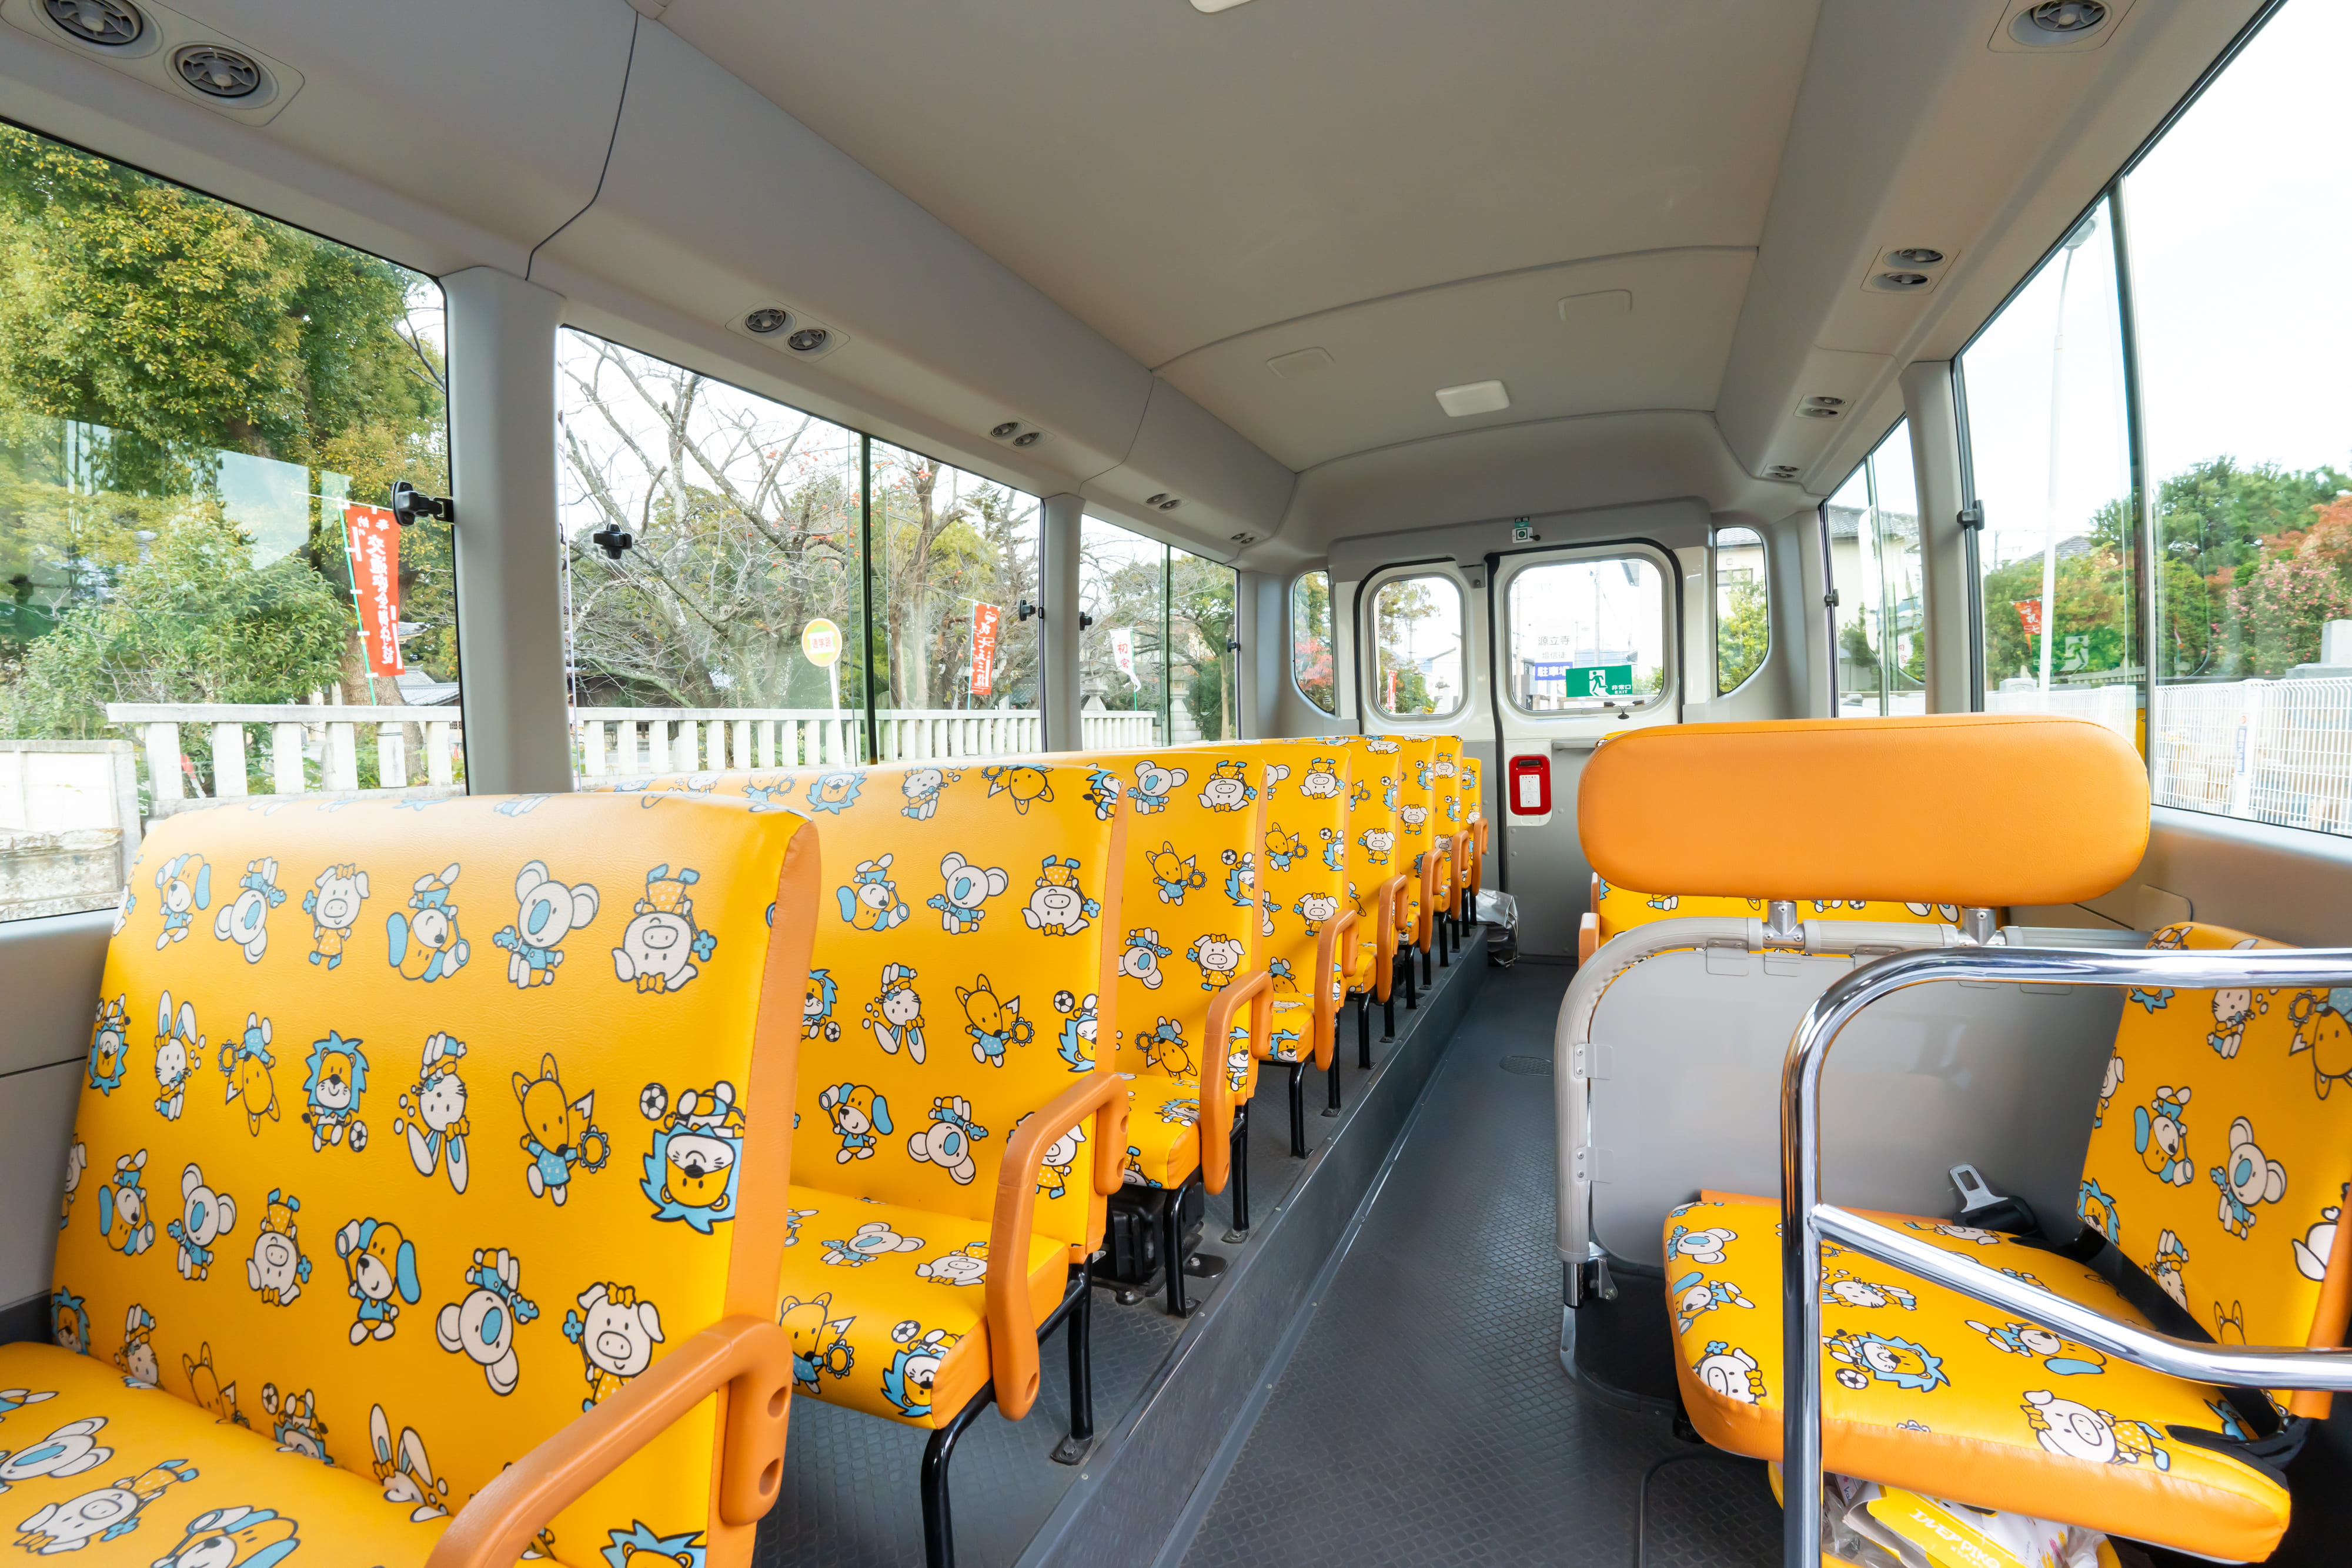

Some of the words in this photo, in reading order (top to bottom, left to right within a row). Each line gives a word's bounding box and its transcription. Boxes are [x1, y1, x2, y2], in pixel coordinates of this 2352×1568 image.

[811, 637, 833, 649] 通学路
[1538, 636, 1571, 646] 源立寺
